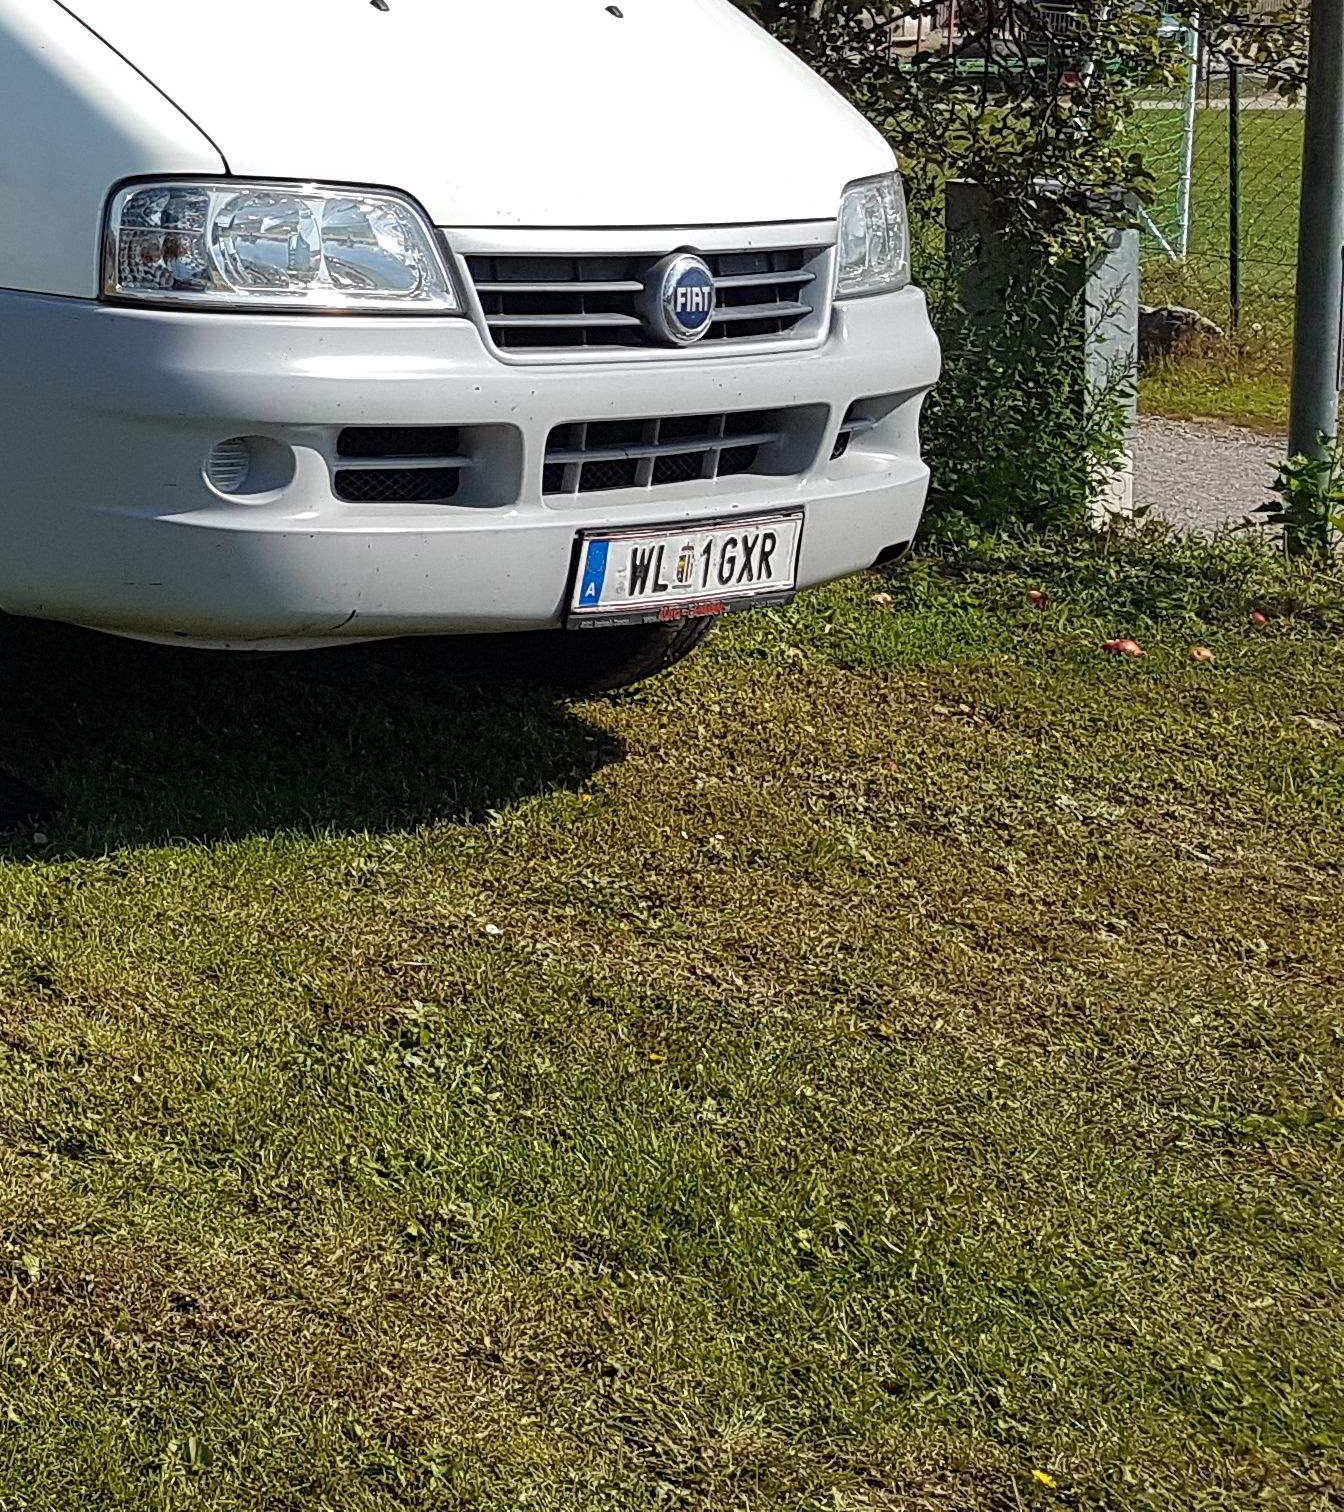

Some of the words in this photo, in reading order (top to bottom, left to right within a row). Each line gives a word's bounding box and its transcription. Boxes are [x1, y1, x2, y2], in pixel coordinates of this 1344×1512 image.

[676, 286, 711, 313] FIAT
[584, 581, 596, 598] A
[628, 544, 669, 596] WL
[700, 531, 777, 588] 1GXR
